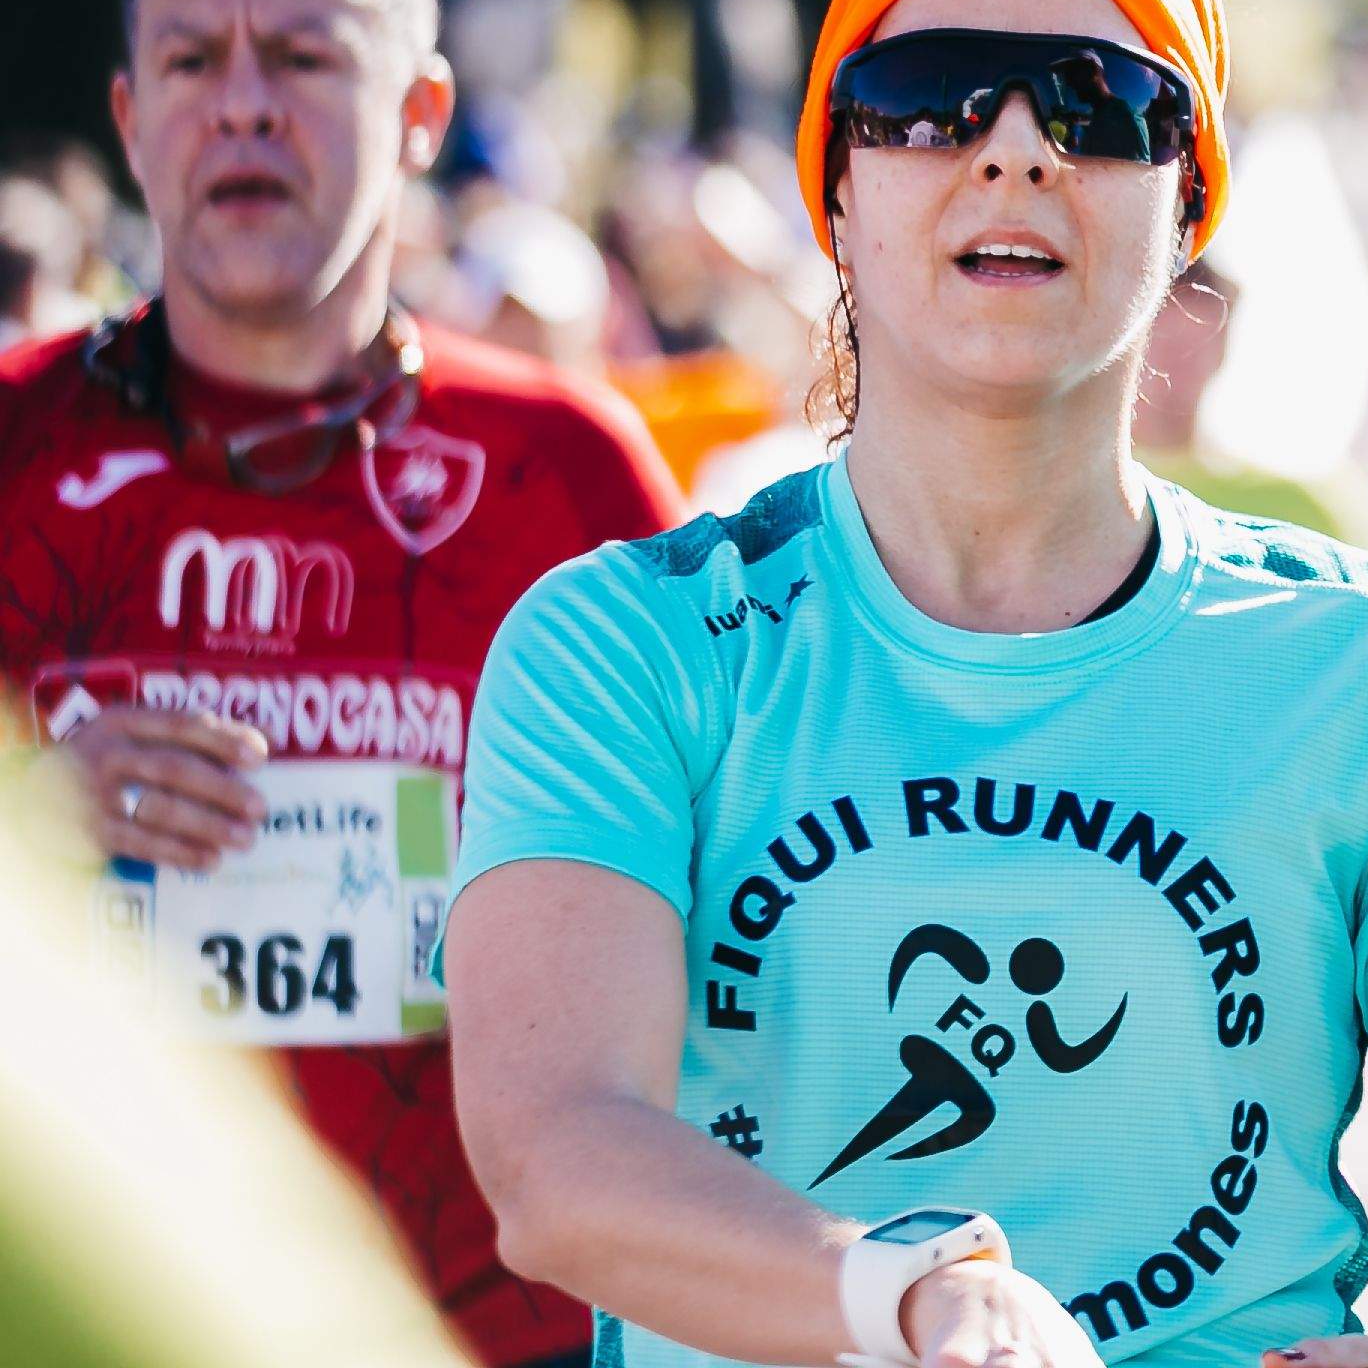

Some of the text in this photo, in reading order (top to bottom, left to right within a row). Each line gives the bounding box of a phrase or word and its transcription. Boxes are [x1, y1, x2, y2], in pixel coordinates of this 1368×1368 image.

[263, 801, 384, 836] etLife
[705, 775, 1266, 1049] FIQUI RUNNERS
[200, 931, 360, 1017] 364
[936, 993, 1017, 1078] FQ
[1066, 1099, 1270, 1342] mones
